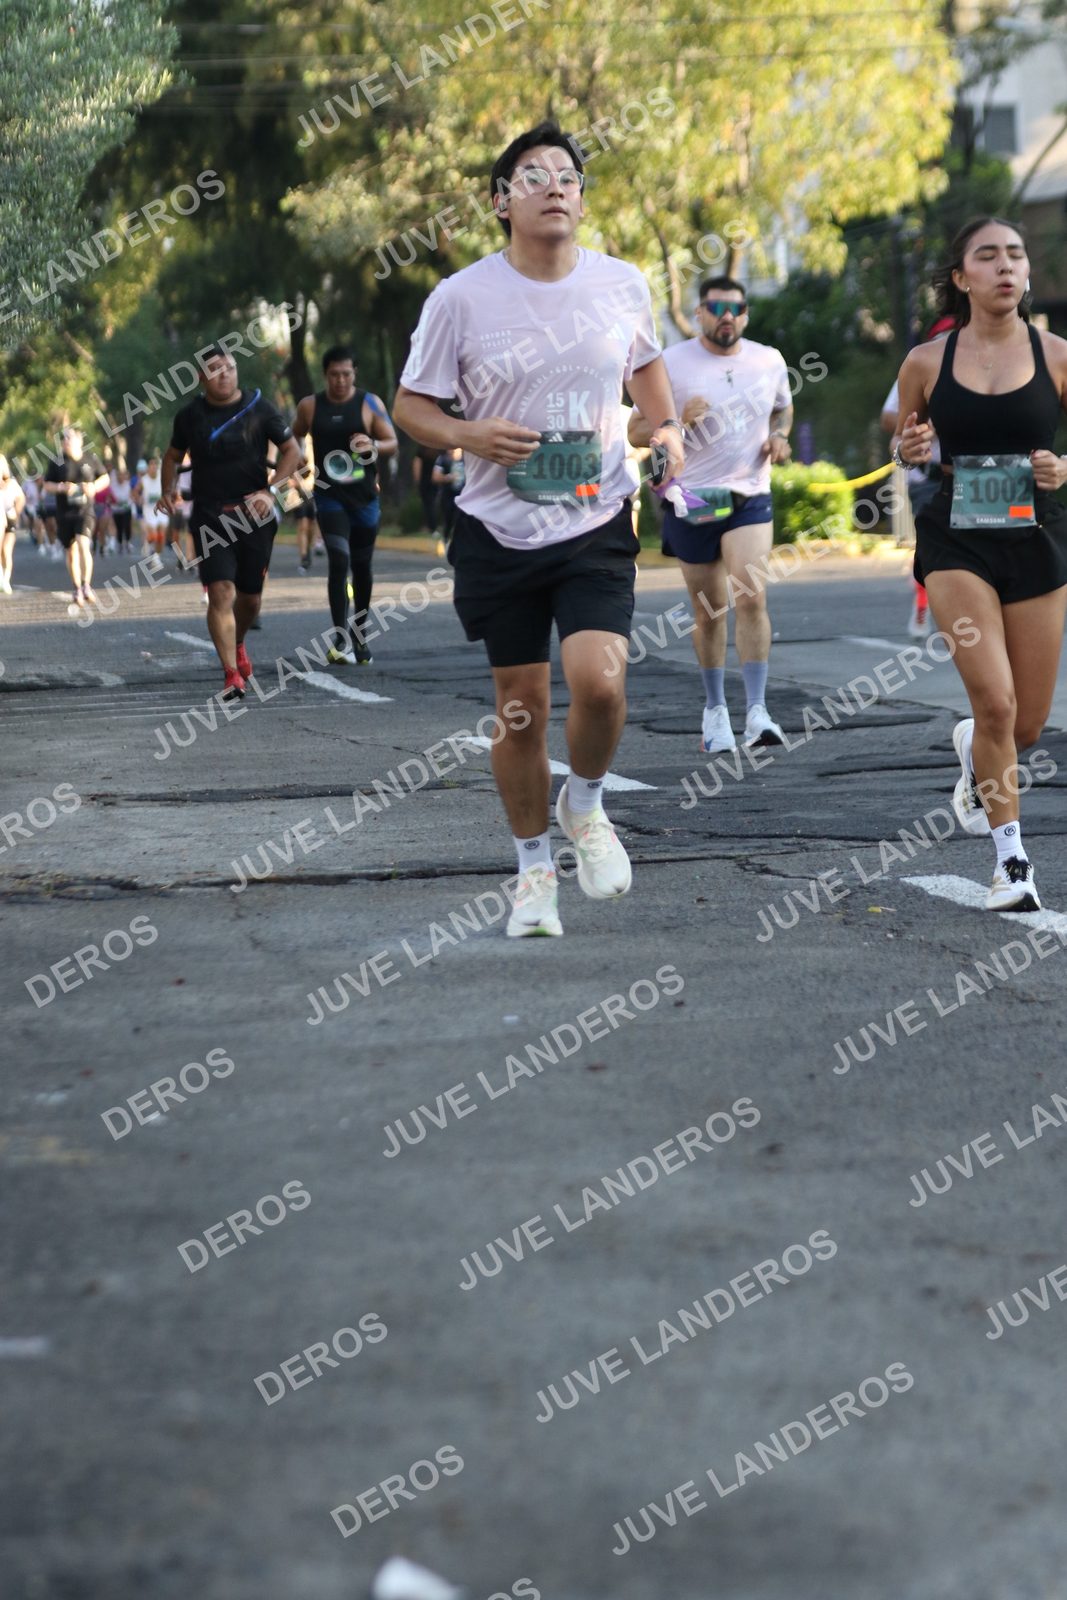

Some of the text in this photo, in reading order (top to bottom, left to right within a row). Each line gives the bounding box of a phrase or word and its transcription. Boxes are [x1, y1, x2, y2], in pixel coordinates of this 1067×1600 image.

[546, 392, 564, 408] 15
[568, 390, 592, 429] K
[546, 414, 564, 430] 30
[533, 452, 602, 480] 1003
